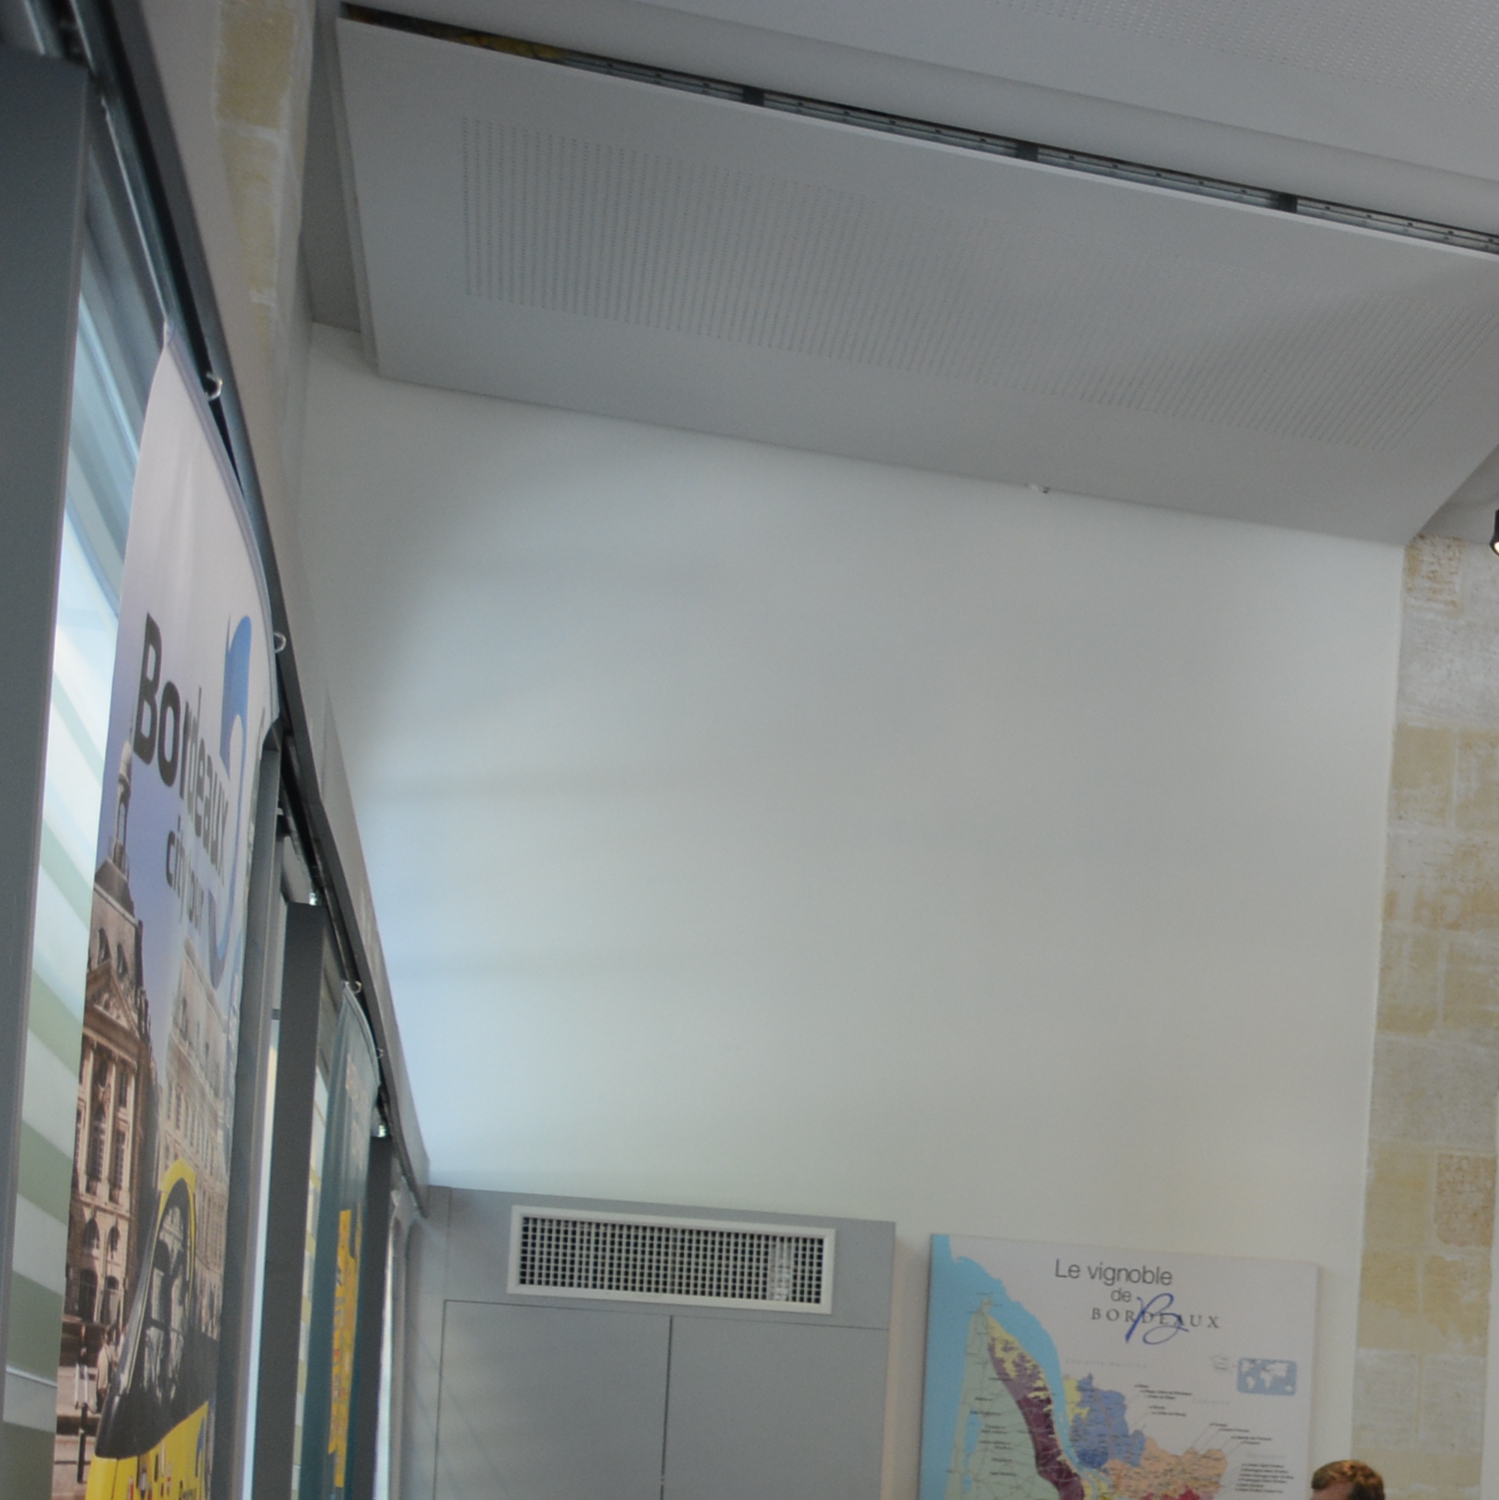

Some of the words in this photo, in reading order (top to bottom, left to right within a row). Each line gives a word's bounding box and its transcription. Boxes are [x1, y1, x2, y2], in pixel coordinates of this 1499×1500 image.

[133, 611, 228, 887] Bordeaux
[1055, 1258, 1081, 1279] Le
[1087, 1262, 1173, 1287] vignoble
[1110, 1288, 1132, 1303] de
[1091, 1307, 1221, 1329] BORDEAUX
